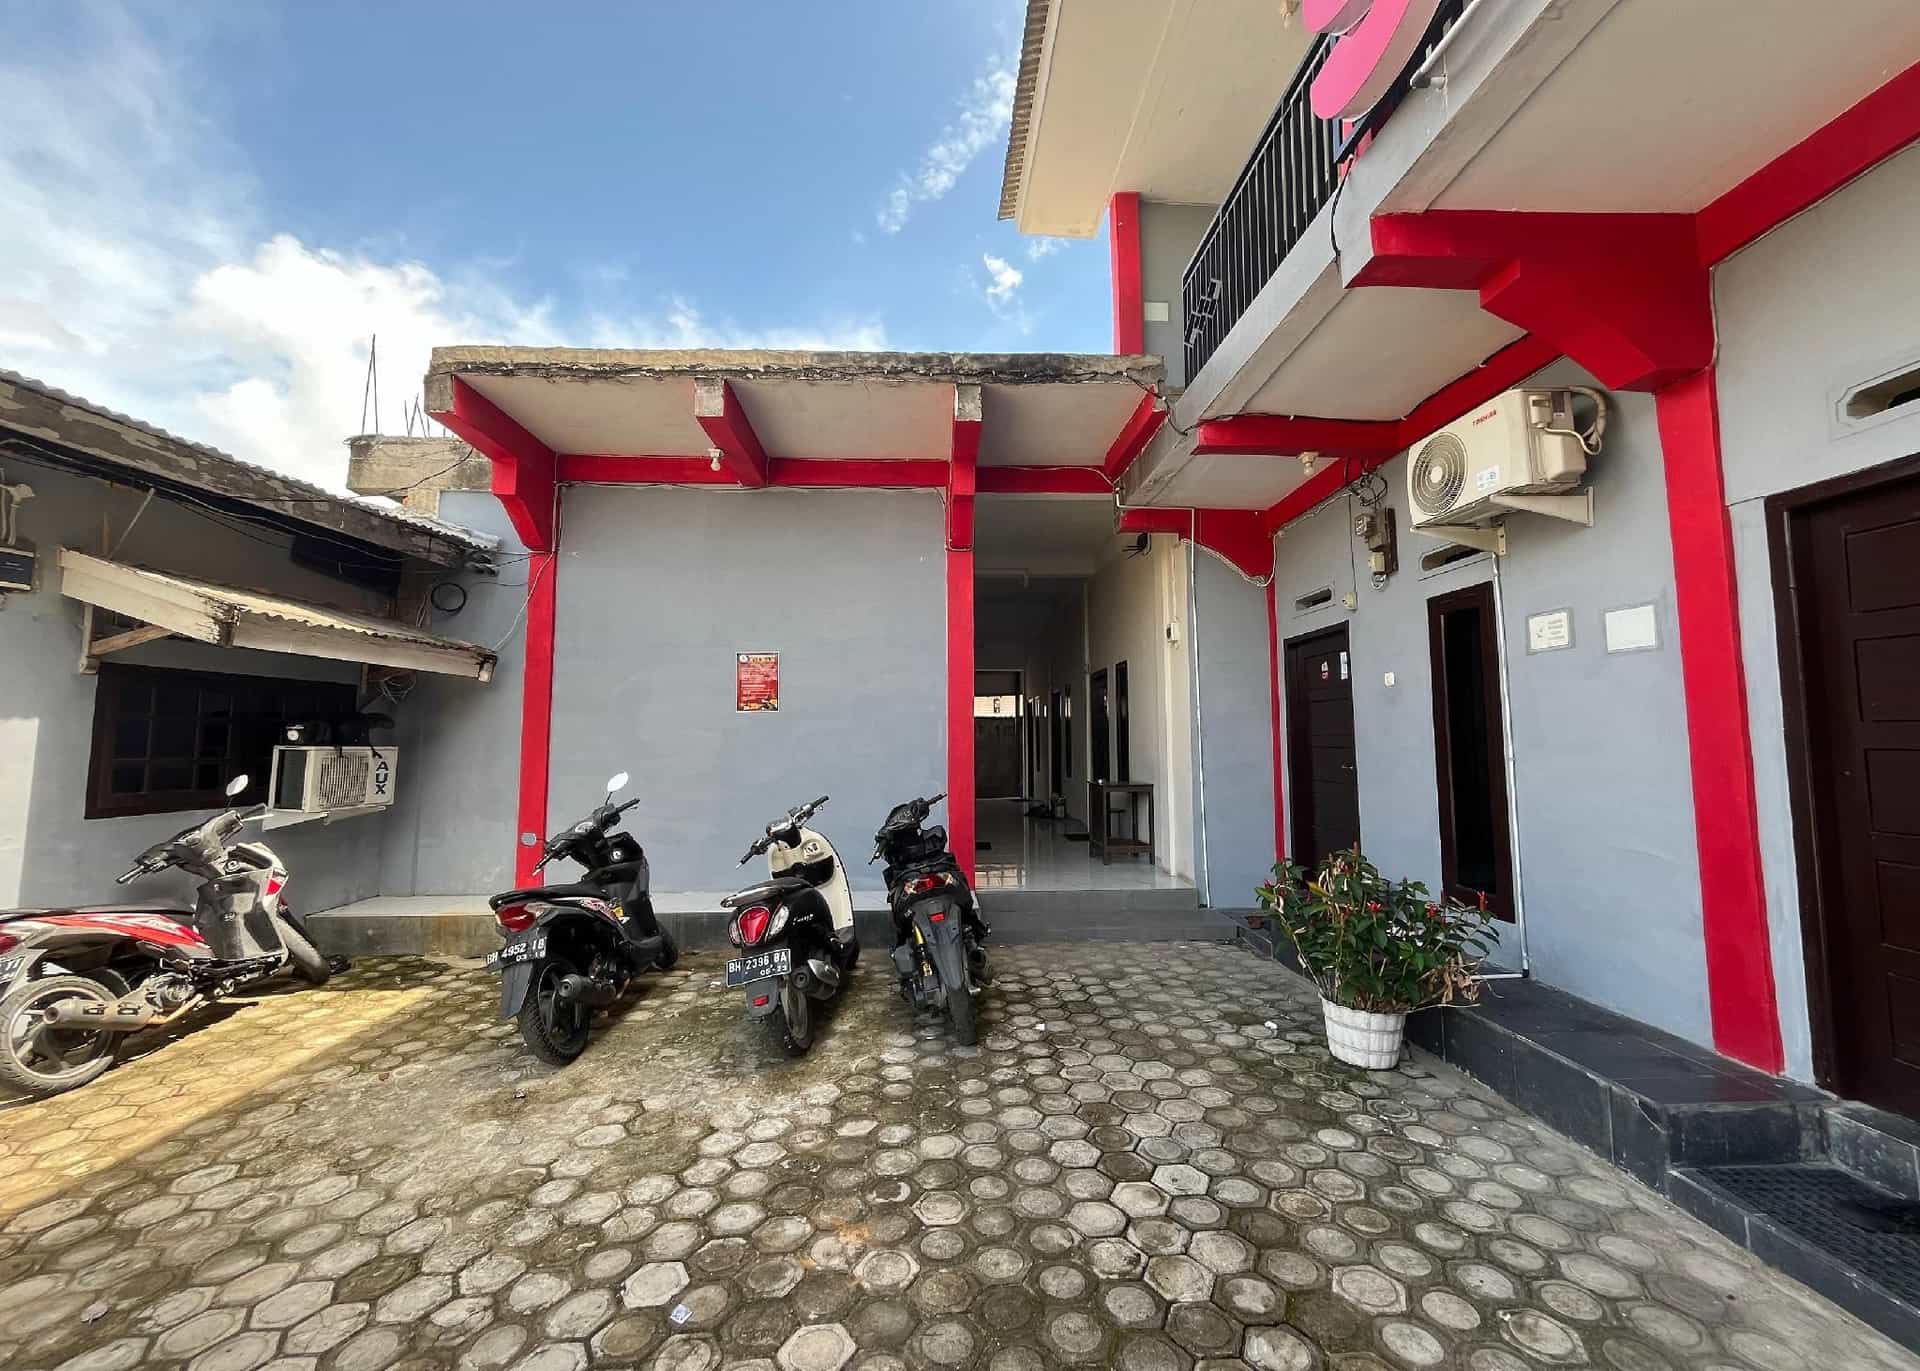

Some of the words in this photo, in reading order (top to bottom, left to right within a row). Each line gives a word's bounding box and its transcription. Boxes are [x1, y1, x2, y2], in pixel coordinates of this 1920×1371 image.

[375, 761, 389, 795] AUX
[486, 952, 499, 965] BH
[501, 943, 527, 958] 4952
[728, 962, 741, 973] BH
[745, 955, 770, 970] 2396
[773, 951, 787, 963] BA
